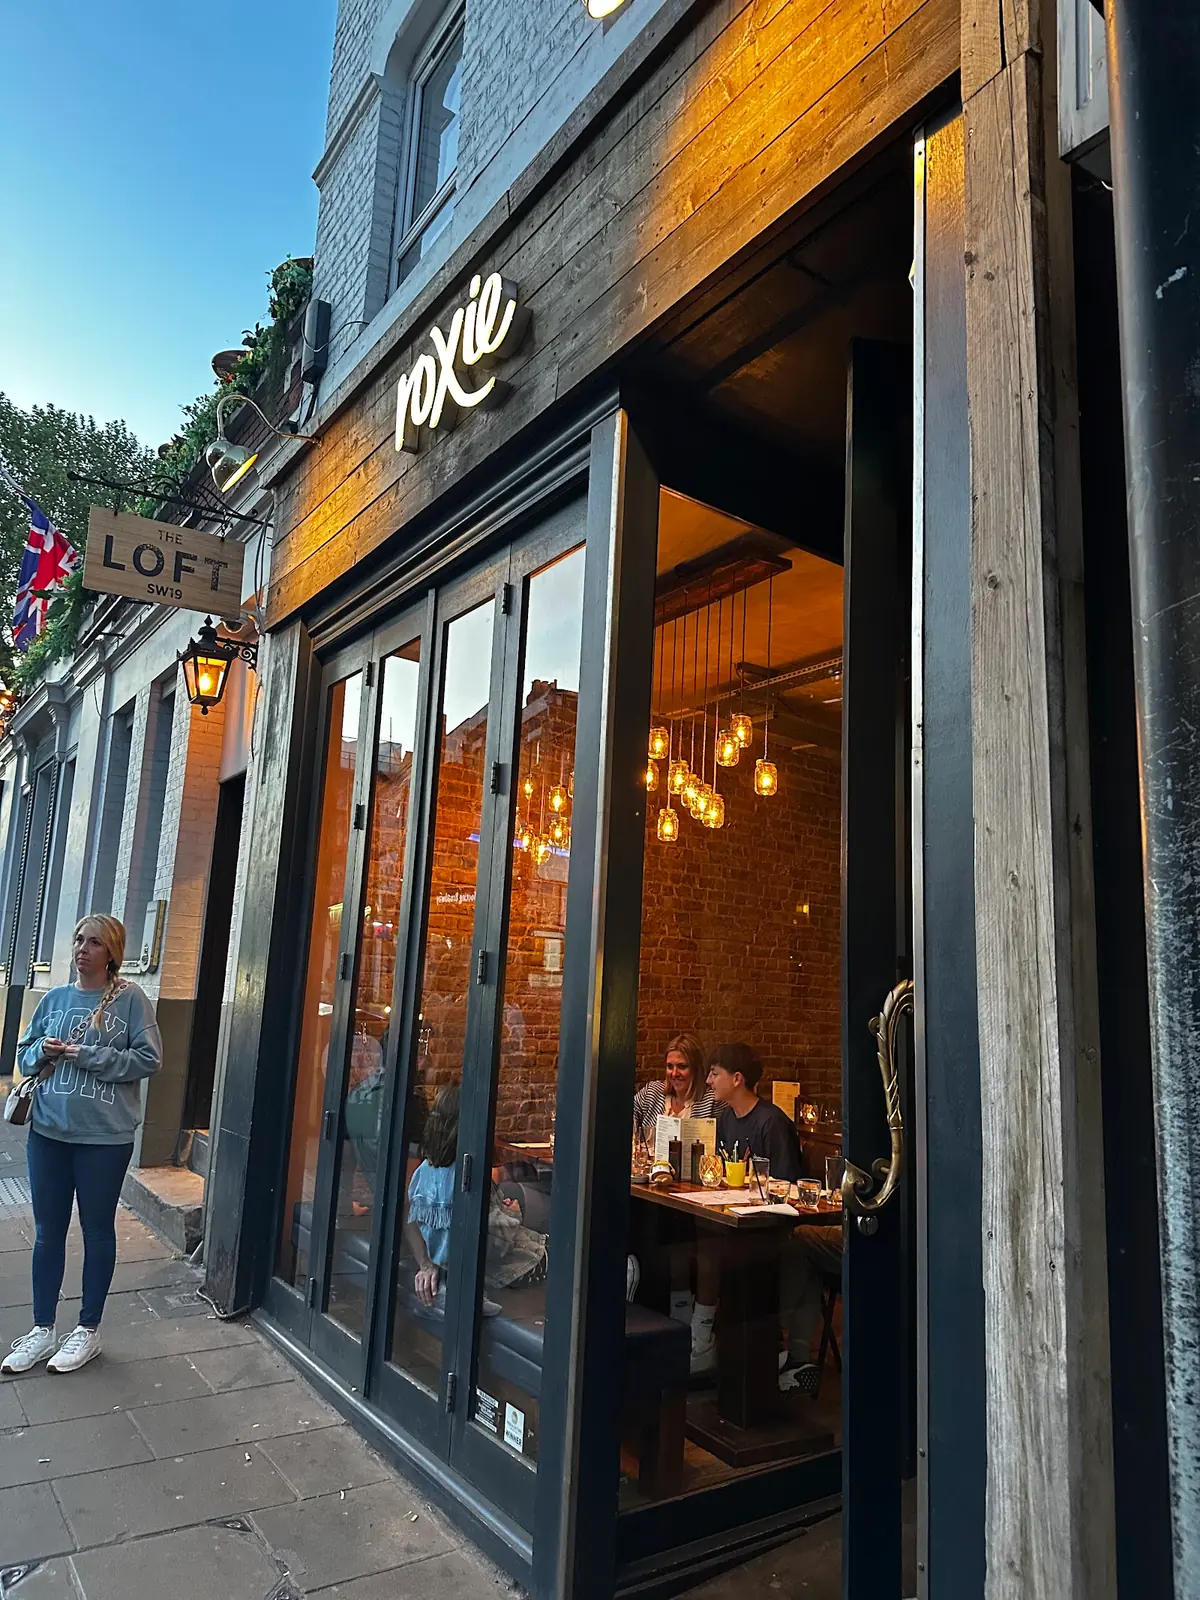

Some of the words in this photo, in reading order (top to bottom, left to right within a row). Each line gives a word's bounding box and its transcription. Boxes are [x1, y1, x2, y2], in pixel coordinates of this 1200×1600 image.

[158, 529, 183, 545] THE
[103, 534, 228, 591] LOFT
[147, 583, 183, 600] SW19
[42, 1060, 116, 1105] OM
[505, 1430, 522, 1446] WINNER
